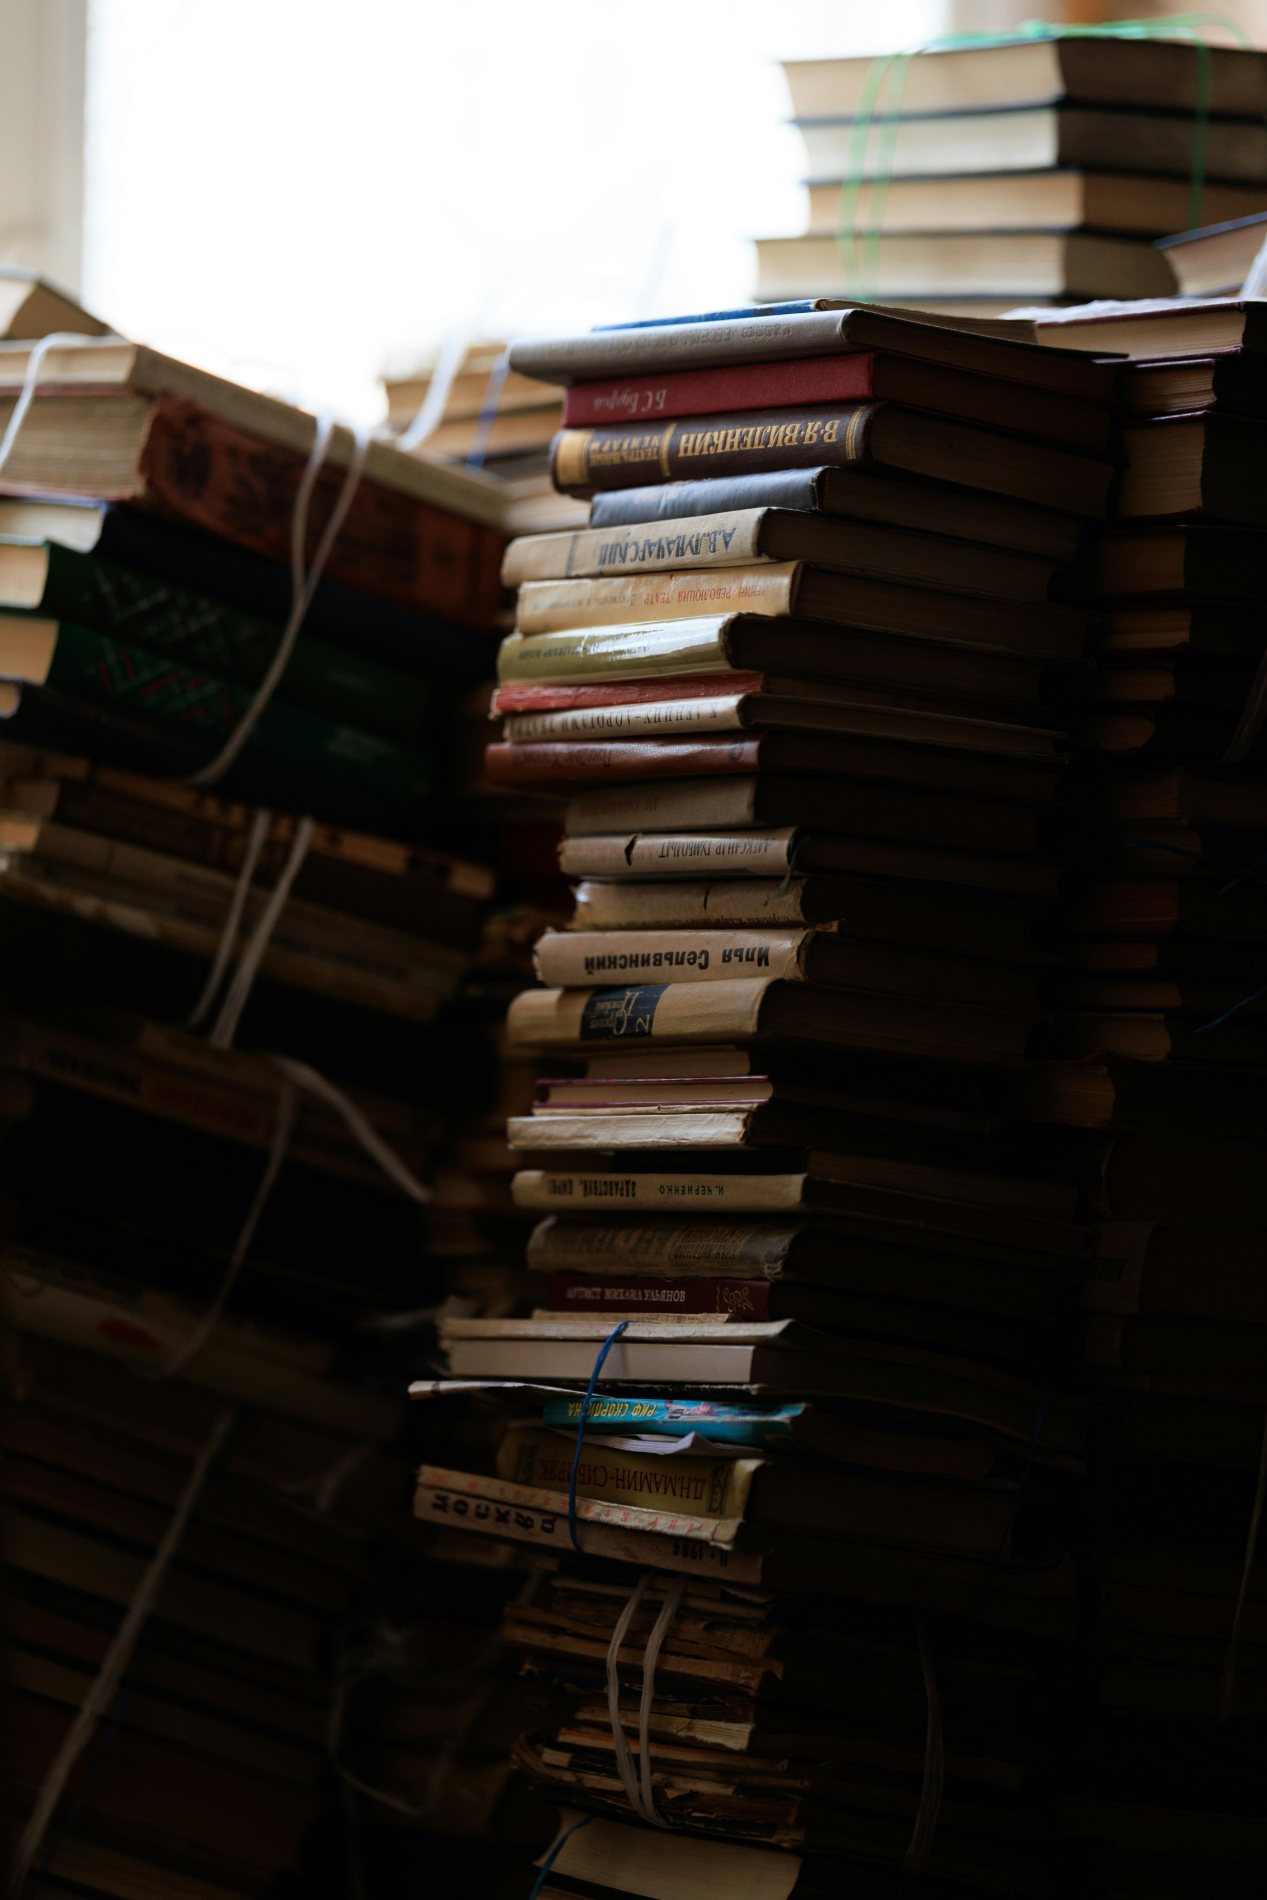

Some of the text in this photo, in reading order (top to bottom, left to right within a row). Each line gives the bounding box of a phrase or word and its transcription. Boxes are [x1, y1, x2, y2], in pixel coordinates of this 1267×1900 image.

[678, 586, 731, 603] РЕВОЛЮЦИЯ
[584, 947, 769, 974] Илья Сельвинский
[644, 1288, 685, 1302] УЛЬЯНОВ
[568, 1402, 657, 1416] РИФ СКОРПИНА
[672, 1541, 703, 1561] 1984
